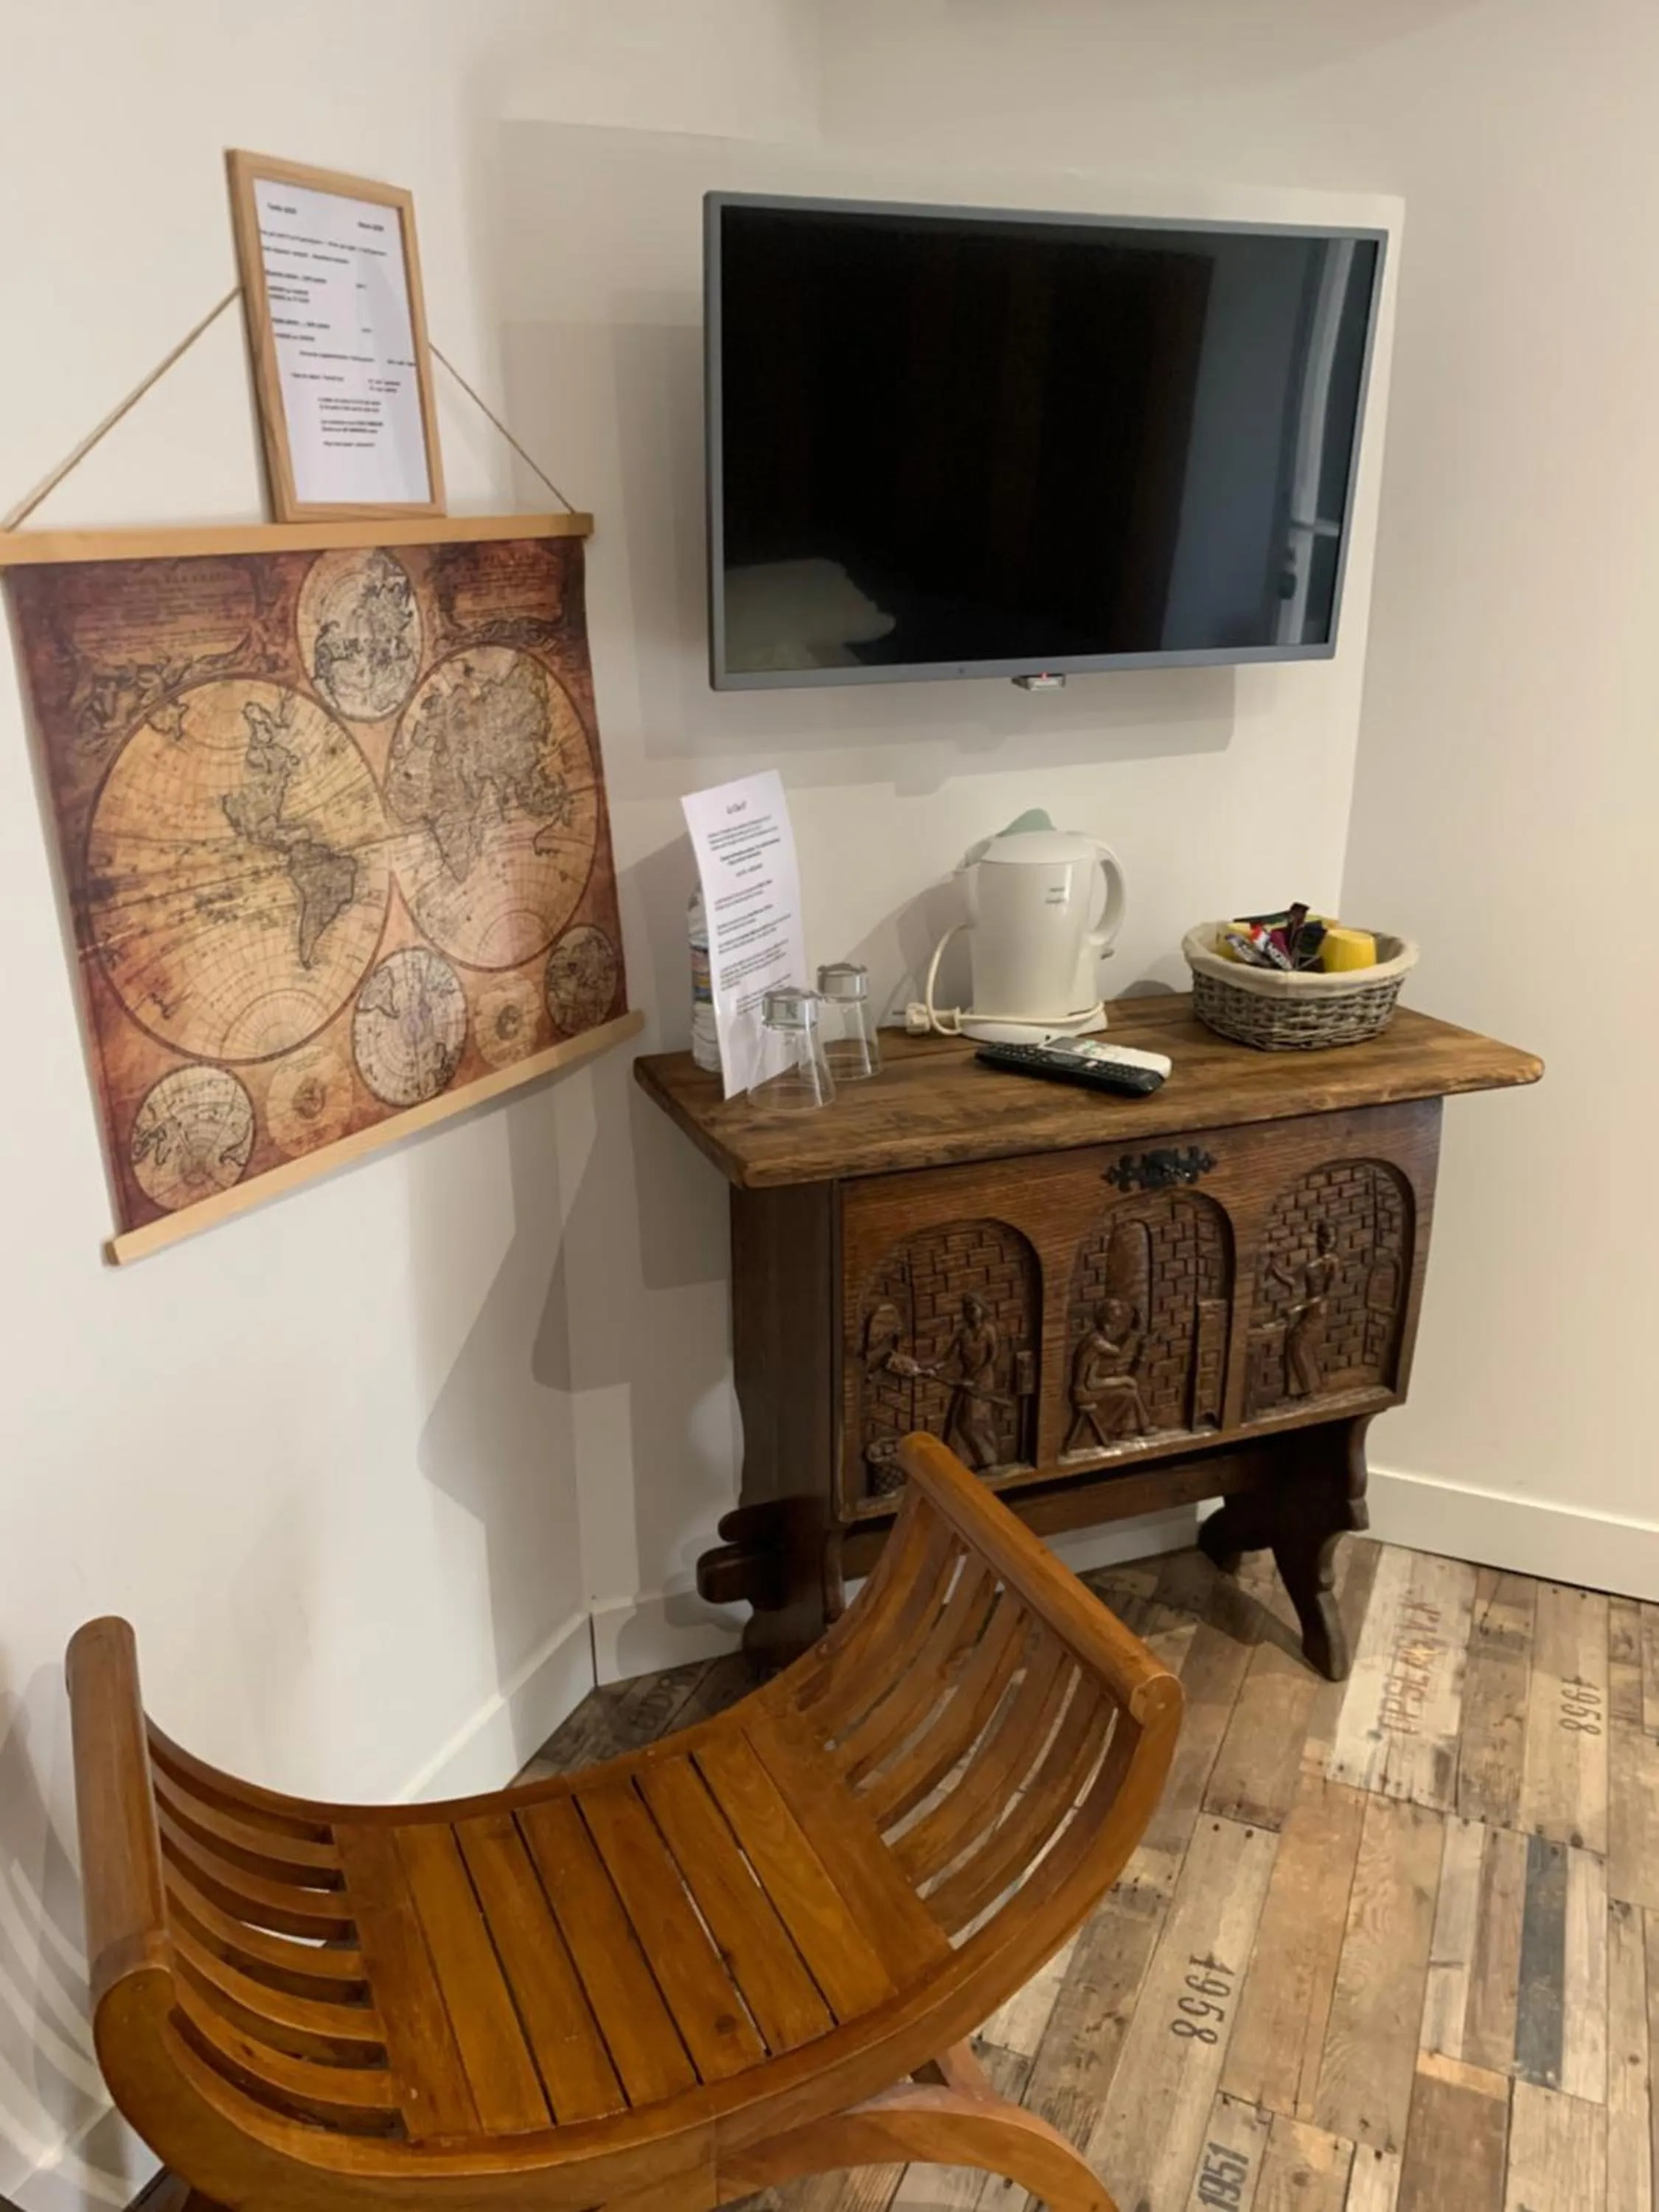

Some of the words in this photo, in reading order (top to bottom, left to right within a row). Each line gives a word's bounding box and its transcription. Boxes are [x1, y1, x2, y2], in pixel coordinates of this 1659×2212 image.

[1558, 1675, 1601, 1736] 1958
[1170, 1952, 1236, 2045] 1958
[1197, 2141, 1250, 2212] 1951
